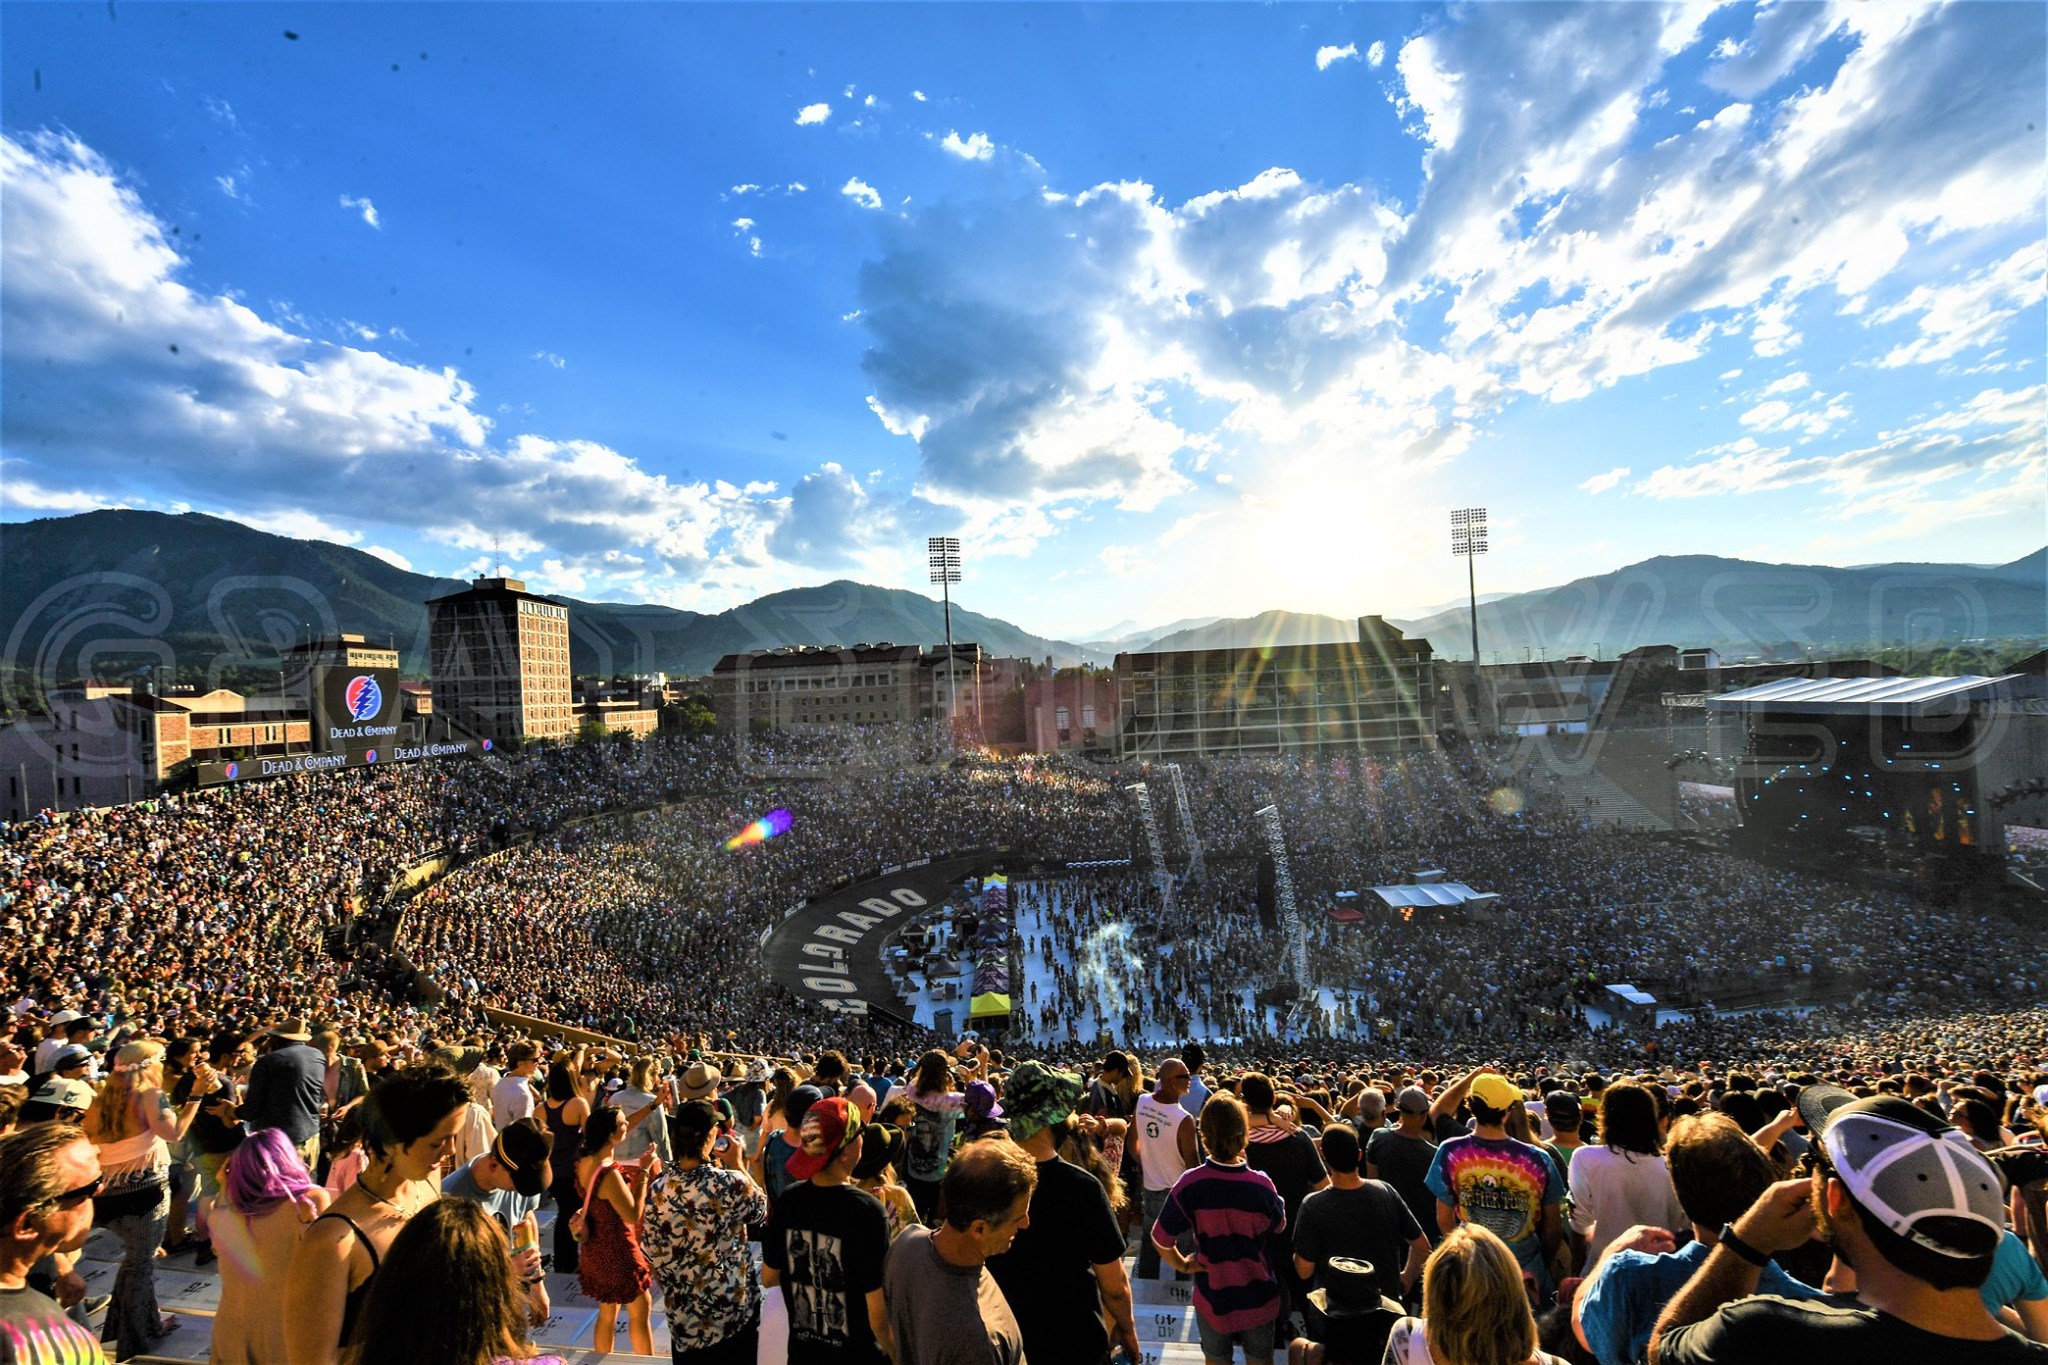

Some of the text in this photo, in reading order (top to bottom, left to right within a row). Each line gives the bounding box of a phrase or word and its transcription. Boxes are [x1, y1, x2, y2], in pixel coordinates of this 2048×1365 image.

[330, 725, 397, 738] DEAD & COMPANY
[394, 743, 467, 760] DEAD & COMPANY
[262, 754, 347, 775] DEAD & COMPANY
